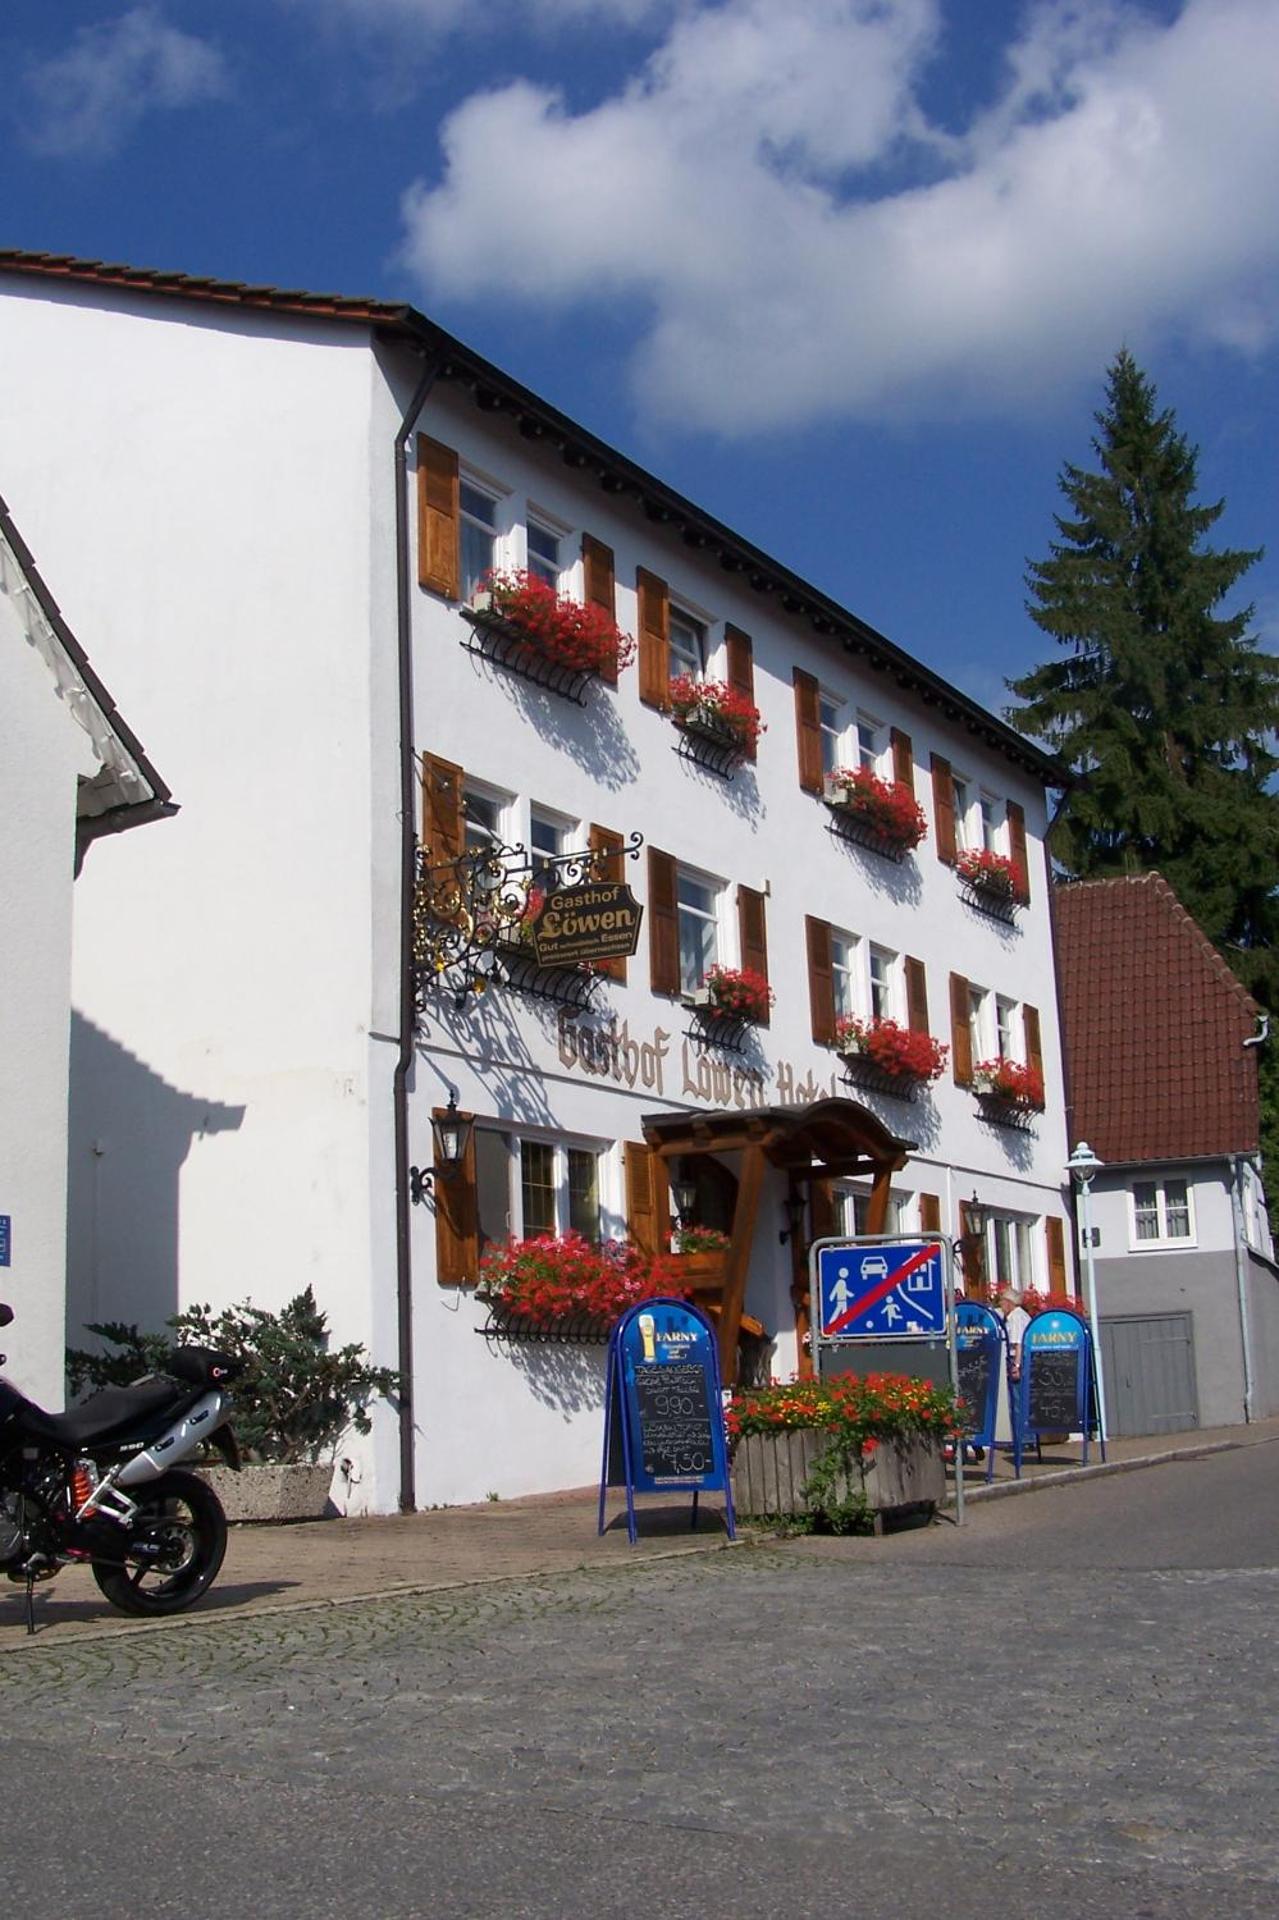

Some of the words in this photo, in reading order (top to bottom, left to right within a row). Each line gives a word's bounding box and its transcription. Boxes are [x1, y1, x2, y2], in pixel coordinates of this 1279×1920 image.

[551, 887, 620, 910] Gasthof
[538, 909, 636, 942] Löwen
[539, 942, 559, 952] Gut
[601, 931, 633, 943] Essen
[557, 1006, 671, 1097] Gasthof
[656, 1331, 698, 1342] FARNY
[1032, 1332, 1077, 1345] FARNY
